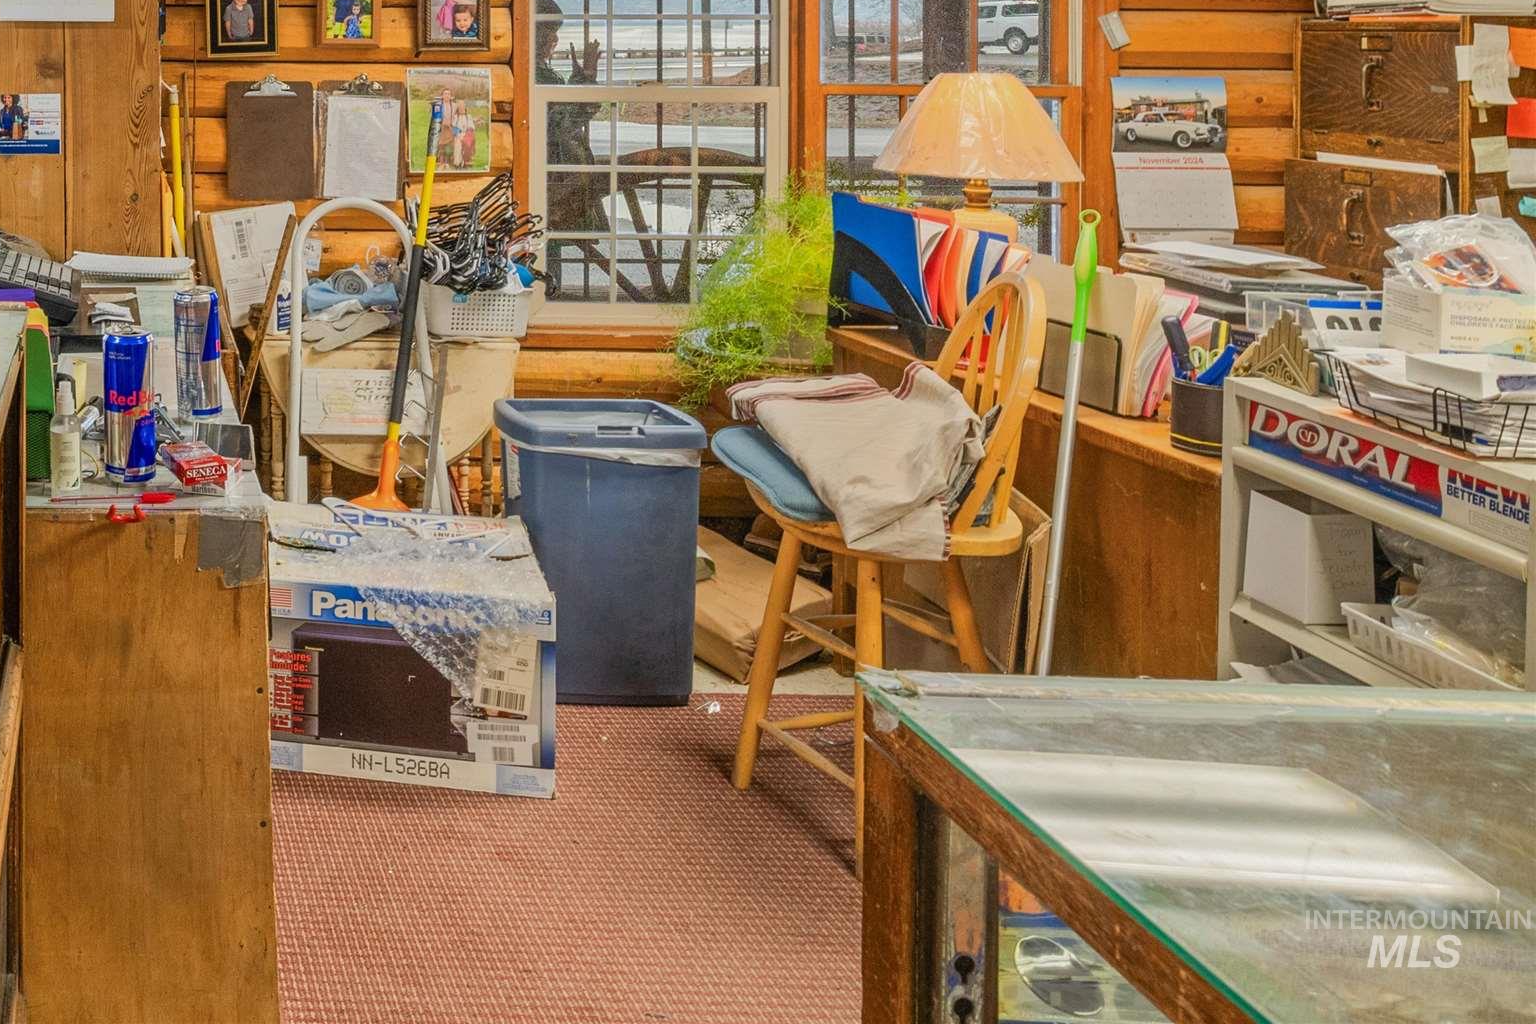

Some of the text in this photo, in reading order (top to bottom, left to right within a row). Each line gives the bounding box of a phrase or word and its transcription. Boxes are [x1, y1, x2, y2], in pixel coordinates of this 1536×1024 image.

[109, 389, 137, 406] Red
[1251, 404, 1416, 491] DORAL
[186, 465, 227, 479] SENECA
[1446, 484, 1486, 509] BETTER
[1489, 500, 1530, 525] BLENDE
[351, 753, 450, 779] NN-L526BA
